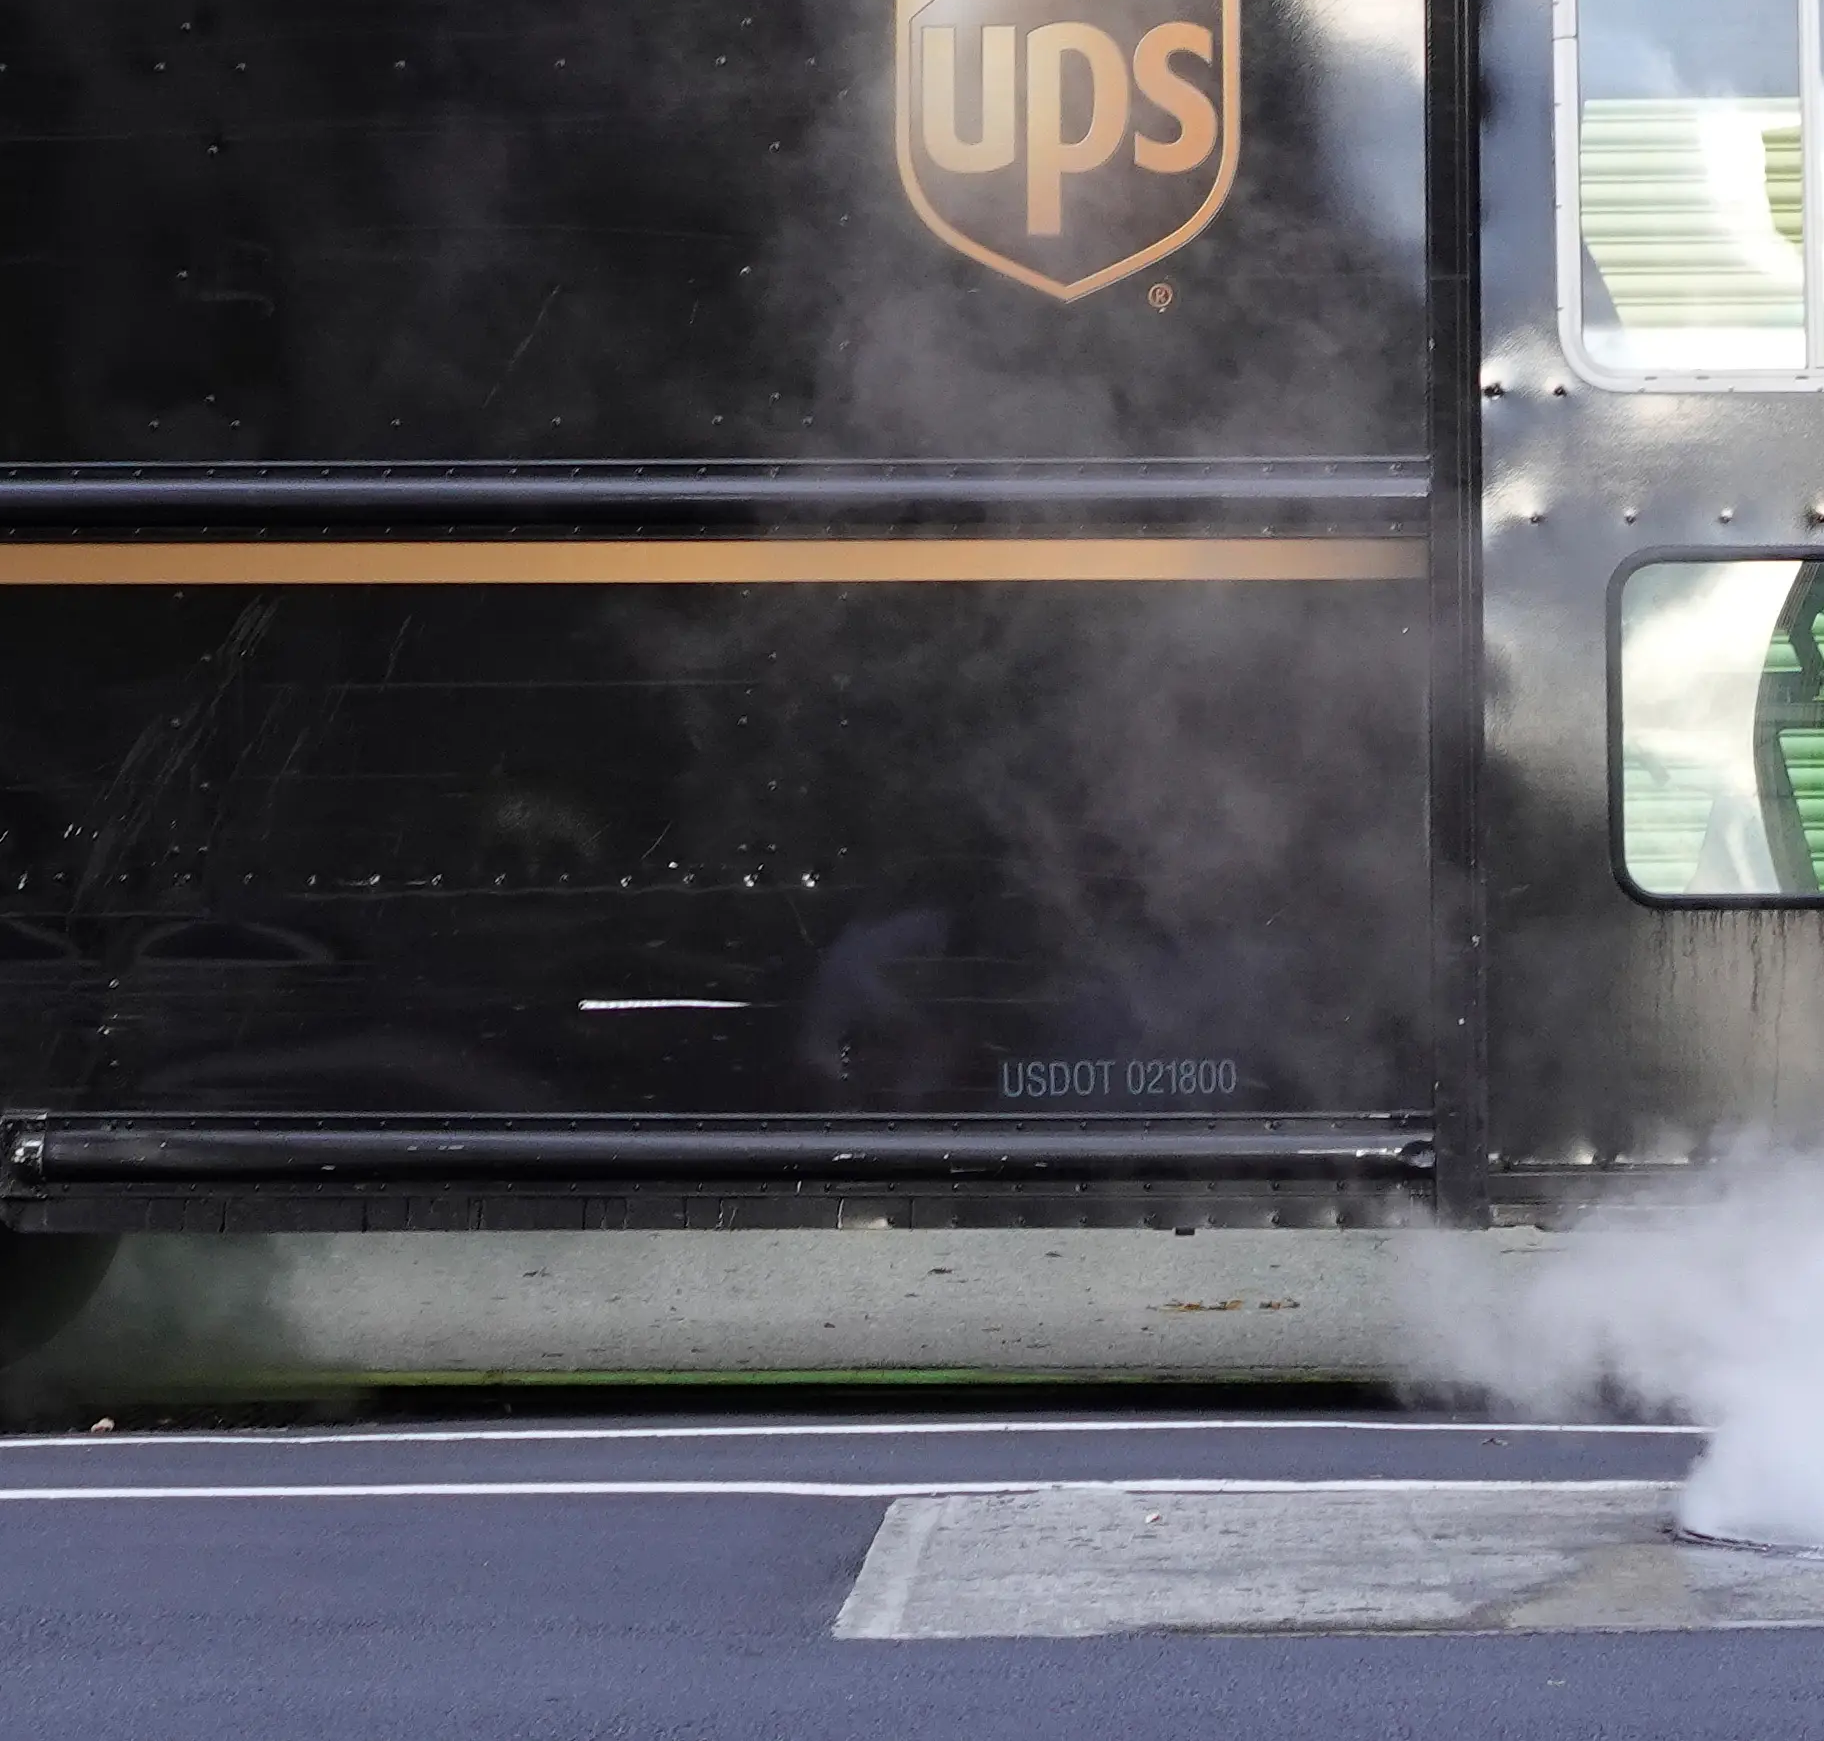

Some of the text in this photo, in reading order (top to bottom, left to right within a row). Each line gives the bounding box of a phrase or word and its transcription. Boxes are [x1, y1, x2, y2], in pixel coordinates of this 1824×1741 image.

[922, 22, 1218, 235] ups
[1003, 1059, 1237, 1097] USDOT 021800
